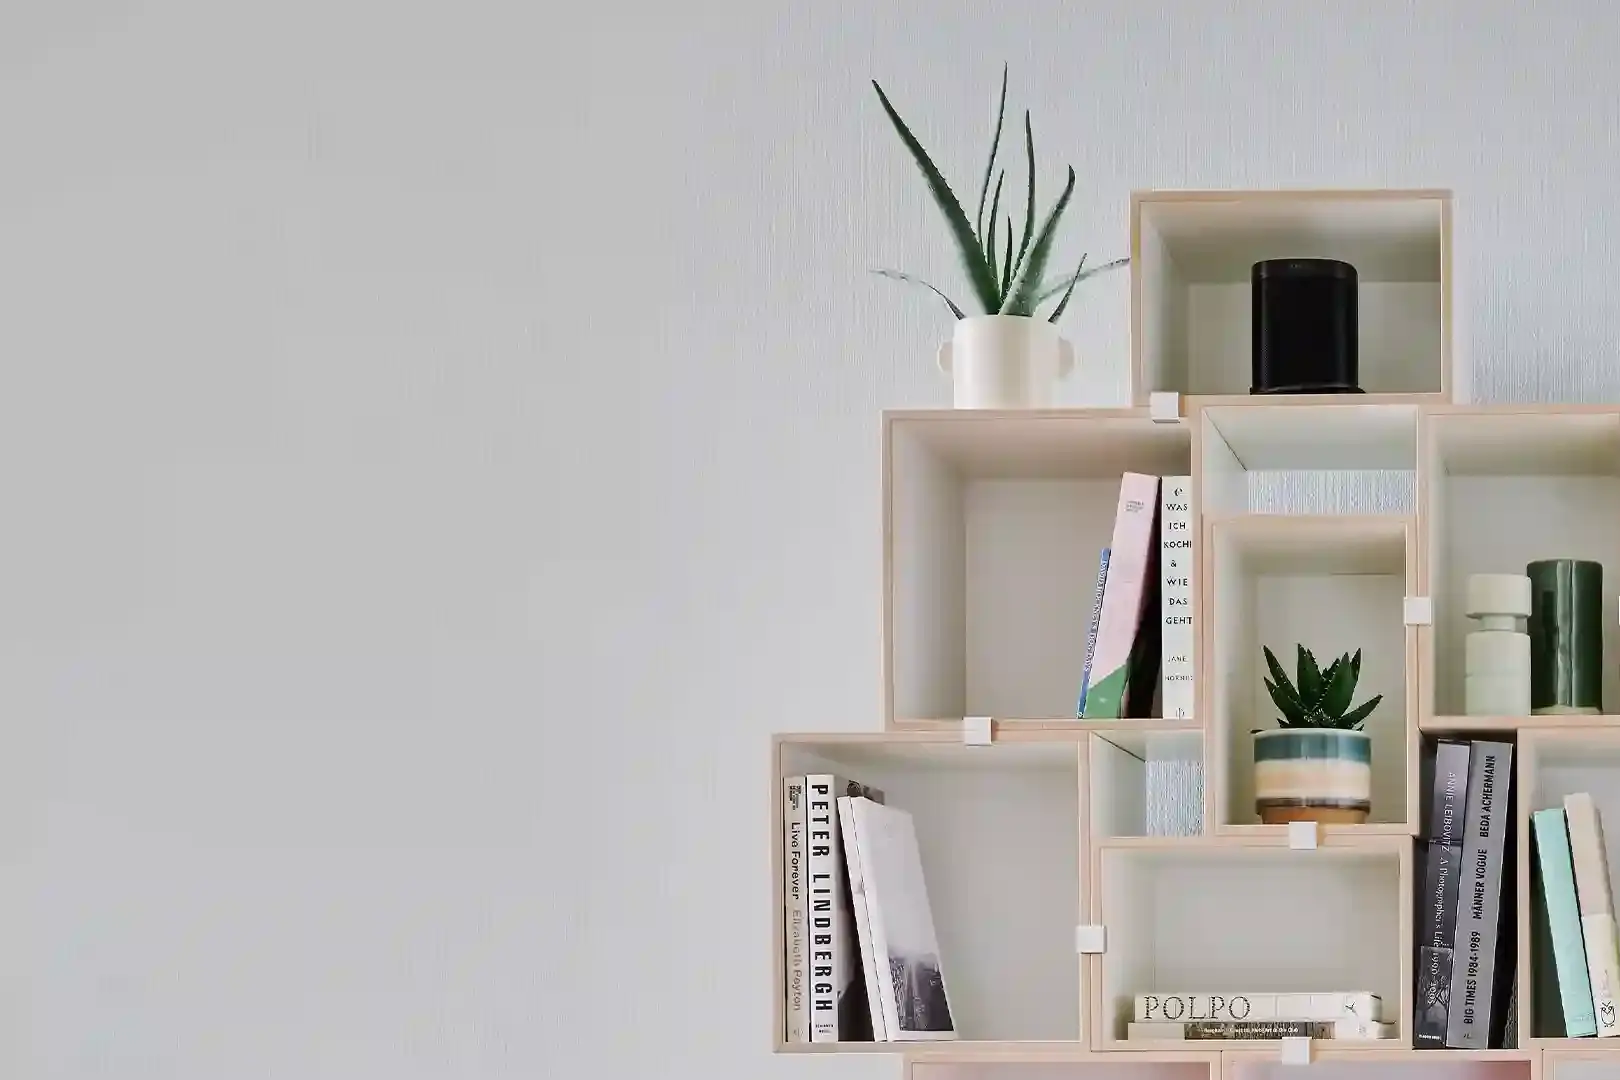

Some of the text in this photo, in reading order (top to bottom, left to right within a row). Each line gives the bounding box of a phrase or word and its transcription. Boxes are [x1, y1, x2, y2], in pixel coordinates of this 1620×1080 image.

[1166, 503, 1188, 511] WAS
[1169, 522, 1186, 530] ICH
[1166, 578, 1188, 587] WIE
[1169, 598, 1187, 606] DAS
[1165, 617, 1192, 625] GEHT
[1445, 772, 1456, 801] ANNIE
[1479, 755, 1496, 838] BEDA ACHERMANN
[811, 784, 829, 857] PETER
[1441, 803, 1454, 852] LEIBOVITZ
[791, 822, 801, 848] Live
[1476, 848, 1488, 874] VOGUE
[791, 850, 801, 900] Forever
[812, 873, 833, 1011] LINDBERGH
[1433, 931, 1443, 947] Life
[1463, 930, 1481, 1025] BIG TIMES 1984-1989
[1143, 996, 1251, 1020] POLPO
